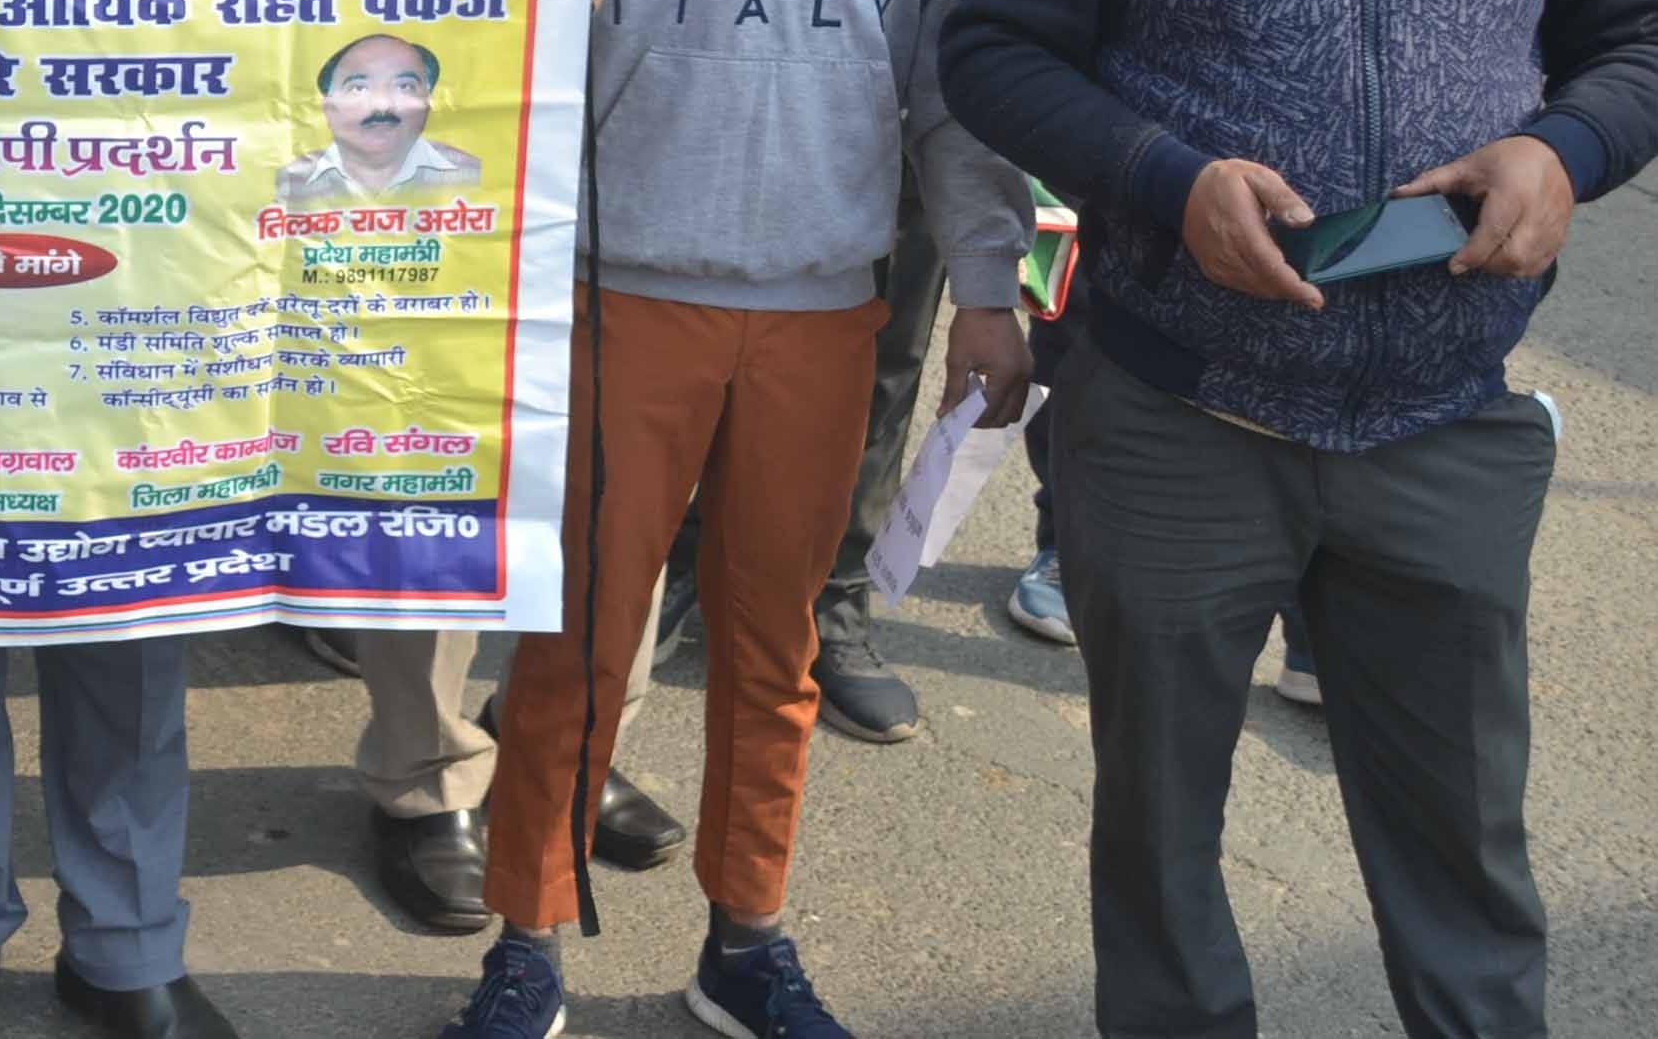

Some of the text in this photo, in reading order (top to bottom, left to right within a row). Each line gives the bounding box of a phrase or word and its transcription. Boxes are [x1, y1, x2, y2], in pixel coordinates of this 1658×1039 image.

[42, 56, 232, 97] सरकार
[62, 121, 237, 178] प्रदर्शन
[97, 193, 187, 224] 2020
[257, 200, 494, 241] तिलक राज अरोरा
[302, 239, 441, 267] प्रदेश महामंत्री
[187, 305, 241, 328] विद्युत
[276, 292, 320, 319] घरेलू
[366, 293, 386, 312] के
[392, 296, 453, 312] बराबर
[96, 332, 137, 352] मंडी
[143, 331, 205, 351] समिति
[211, 329, 259, 354] शुल्क
[265, 324, 322, 340] समाप्त
[95, 360, 175, 380] संविधान
[181, 358, 198, 376] में
[277, 348, 330, 368] करके
[337, 346, 406, 366] व्यापारी
[29, 386, 48, 407] से
[222, 385, 249, 399] का
[117, 439, 209, 471] कंवरवीर
[324, 426, 475, 456] रवि संगल
[131, 463, 281, 509] जिला महामंत्री
[319, 466, 473, 493] नगर महामंत्री
[18, 532, 131, 563] उद्योग
[138, 515, 261, 549] व्यापार
[266, 502, 373, 538] मंडल
[56, 563, 179, 596] उत्तर
[184, 549, 295, 584] प्रदेश
